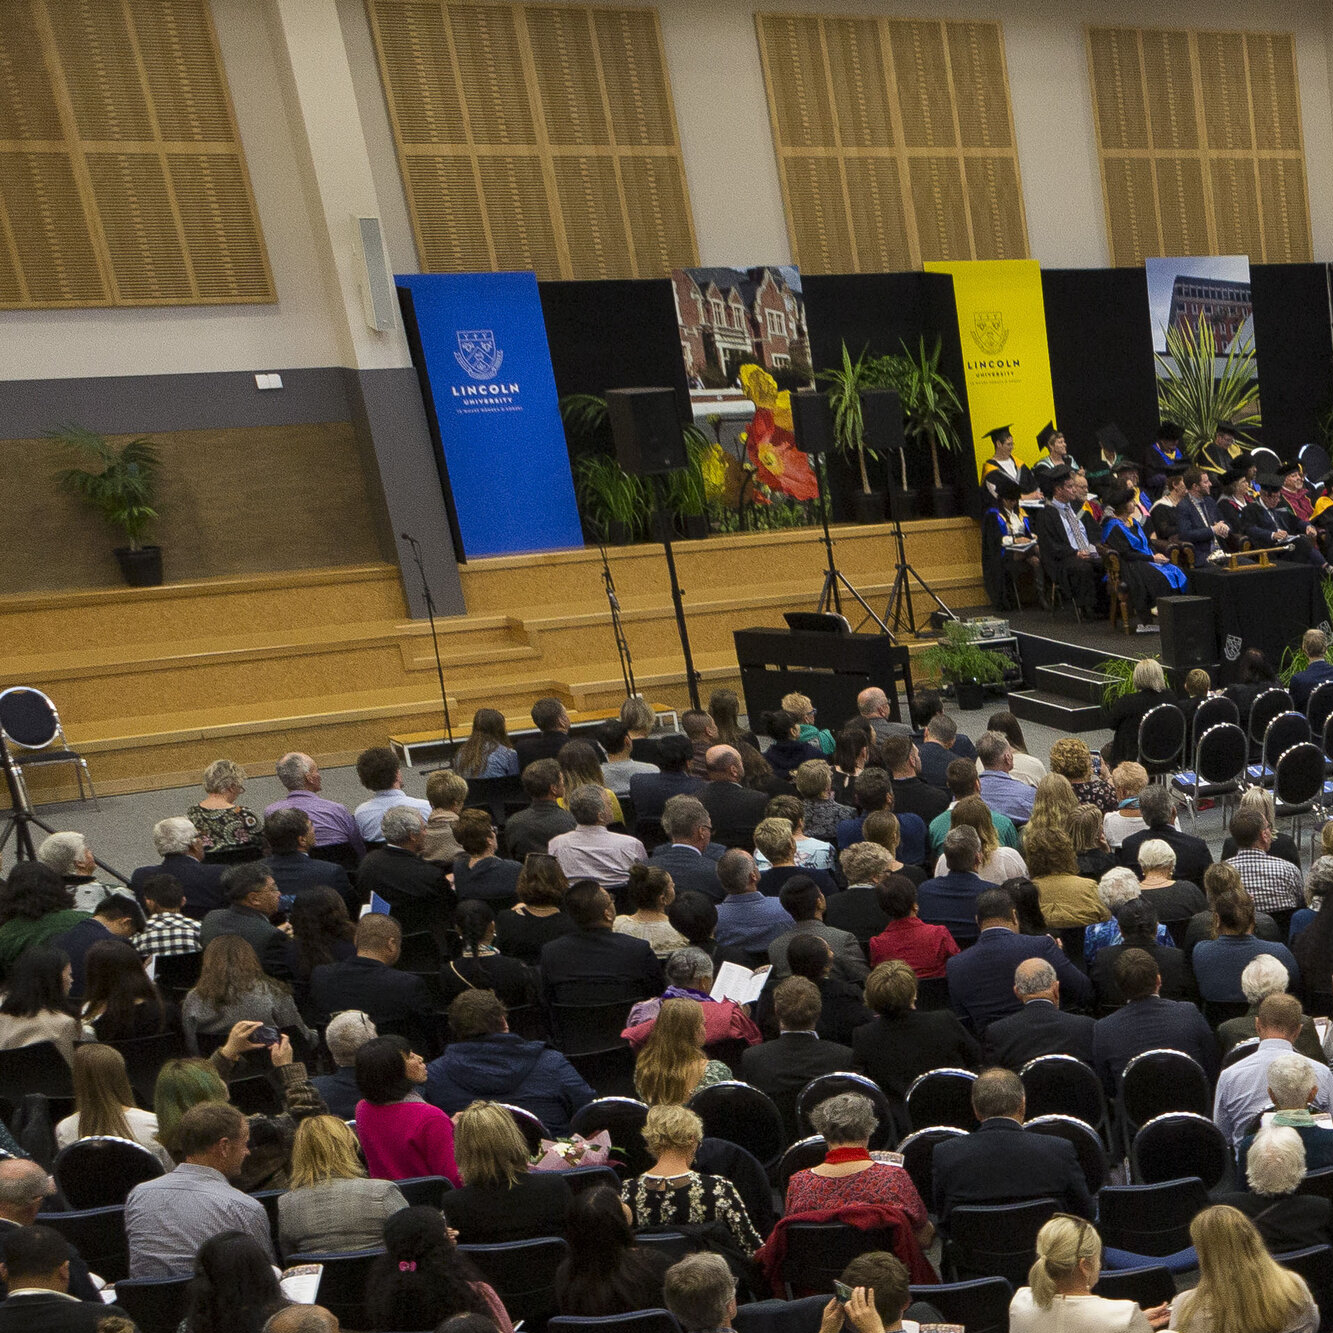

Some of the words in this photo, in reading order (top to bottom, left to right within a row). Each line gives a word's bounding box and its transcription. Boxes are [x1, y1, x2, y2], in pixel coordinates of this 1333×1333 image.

[967, 359, 1021, 370] LINCOLN
[451, 383, 520, 397] LINCOLN
[463, 397, 513, 406] UNIVERSITY
